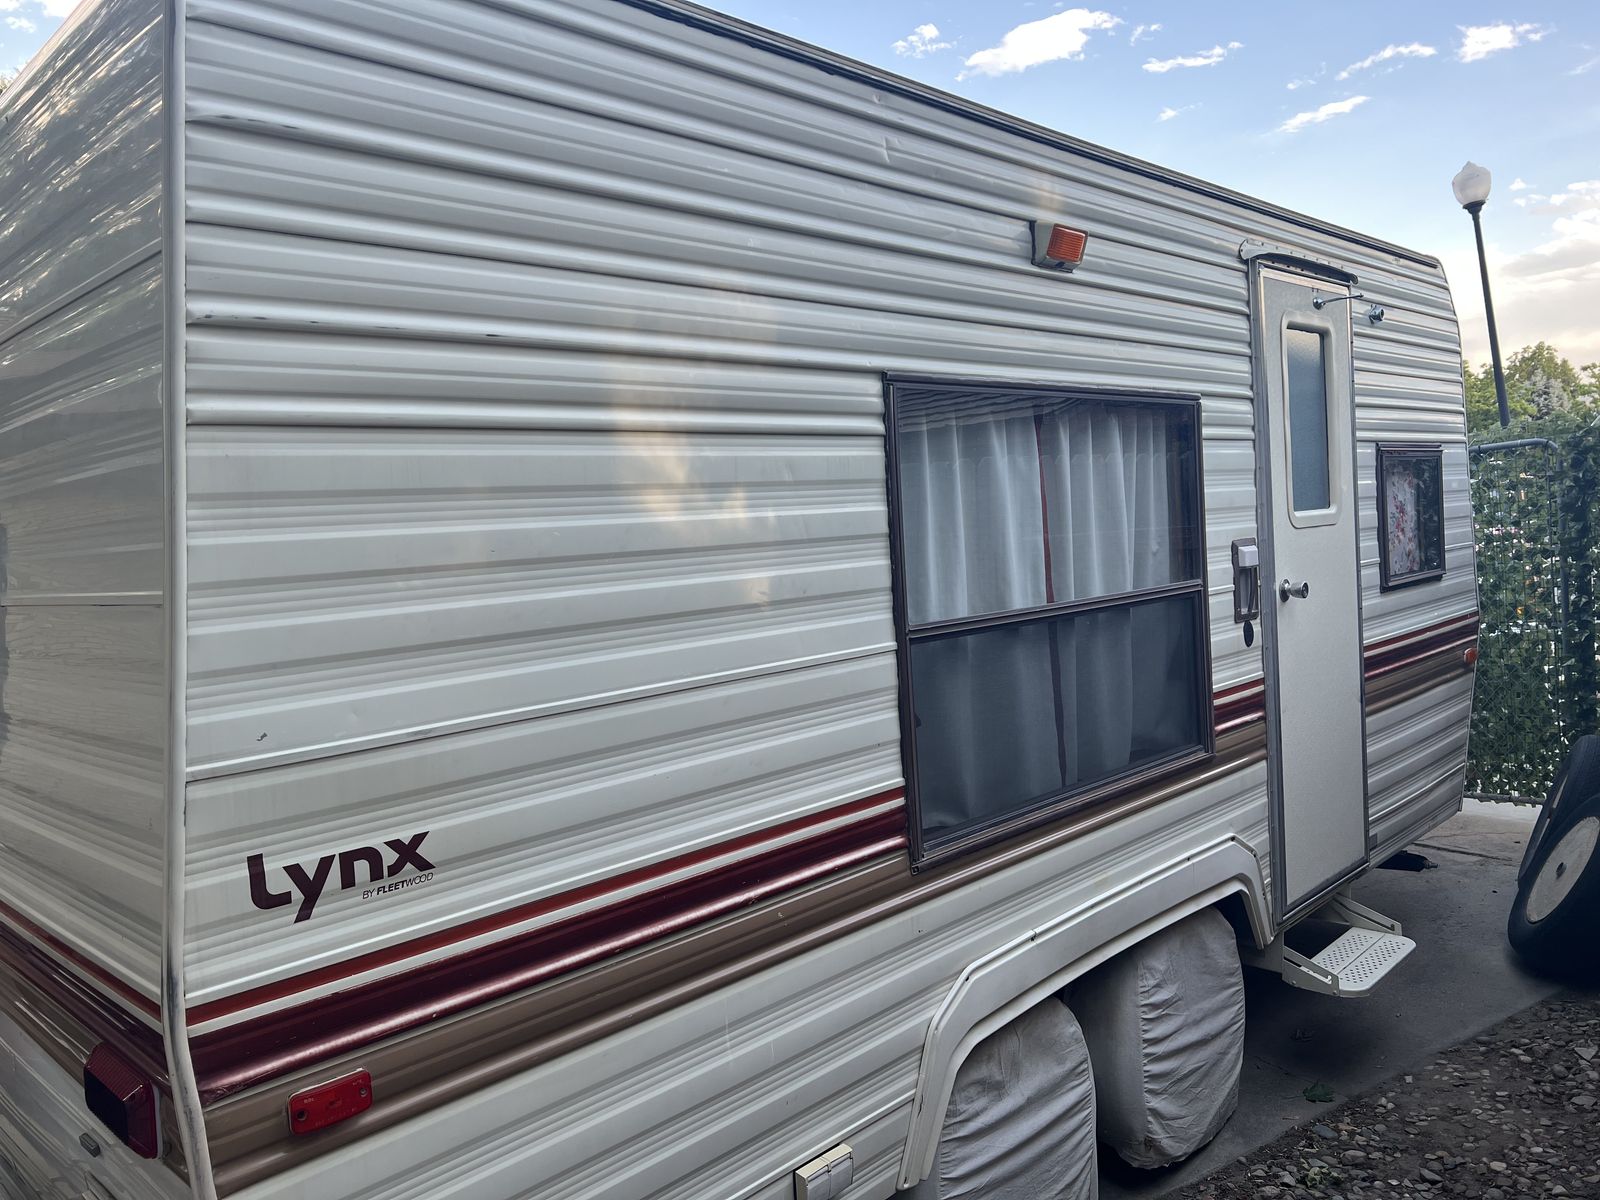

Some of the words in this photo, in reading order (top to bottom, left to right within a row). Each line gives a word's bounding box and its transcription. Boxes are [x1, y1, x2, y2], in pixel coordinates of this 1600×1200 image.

[247, 831, 436, 924] Lynx
[362, 888, 376, 900] BY
[377, 872, 434, 896] FLEETWOOD
